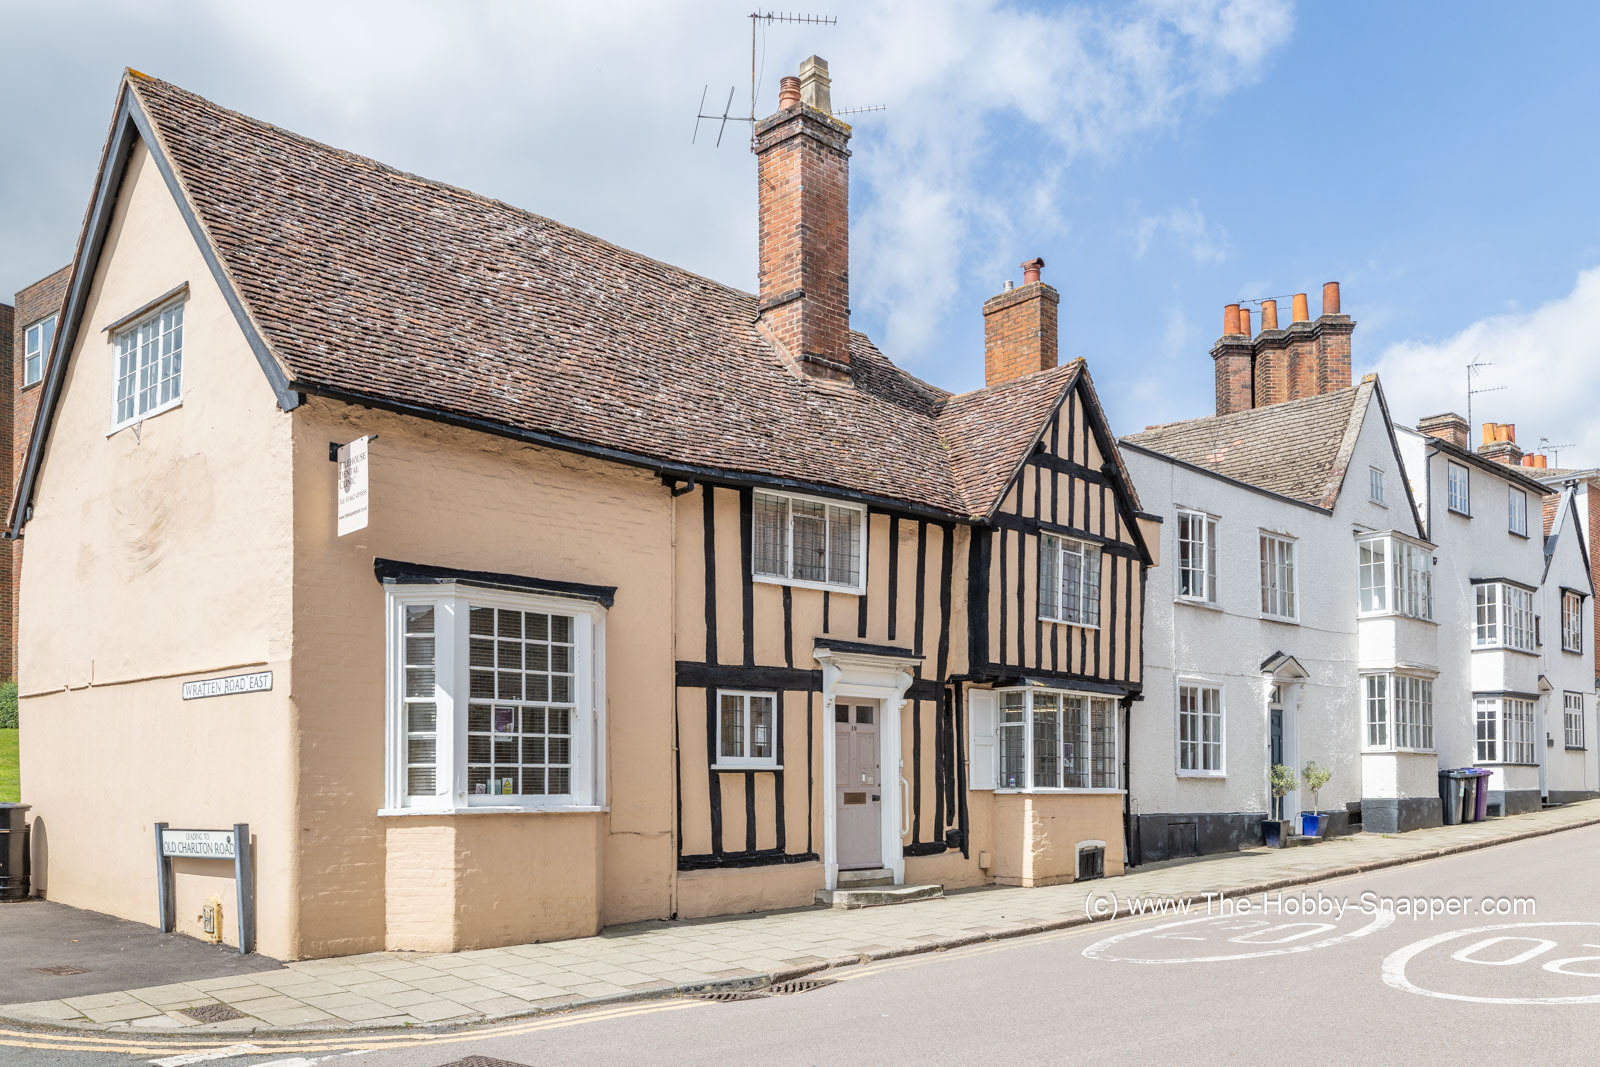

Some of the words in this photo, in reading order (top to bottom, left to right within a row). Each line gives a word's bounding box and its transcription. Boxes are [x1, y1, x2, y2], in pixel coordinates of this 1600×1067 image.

[340, 465, 359, 480] DENTAL
[185, 682, 221, 697] WRATTEN
[225, 678, 245, 693] ROAD
[249, 674, 269, 689] EAST
[186, 833, 203, 841] LEADING
[204, 833, 210, 841] TO
[164, 841, 176, 853] OLD
[178, 842, 213, 854] CHARLTON
[215, 843, 234, 855] ROAD
